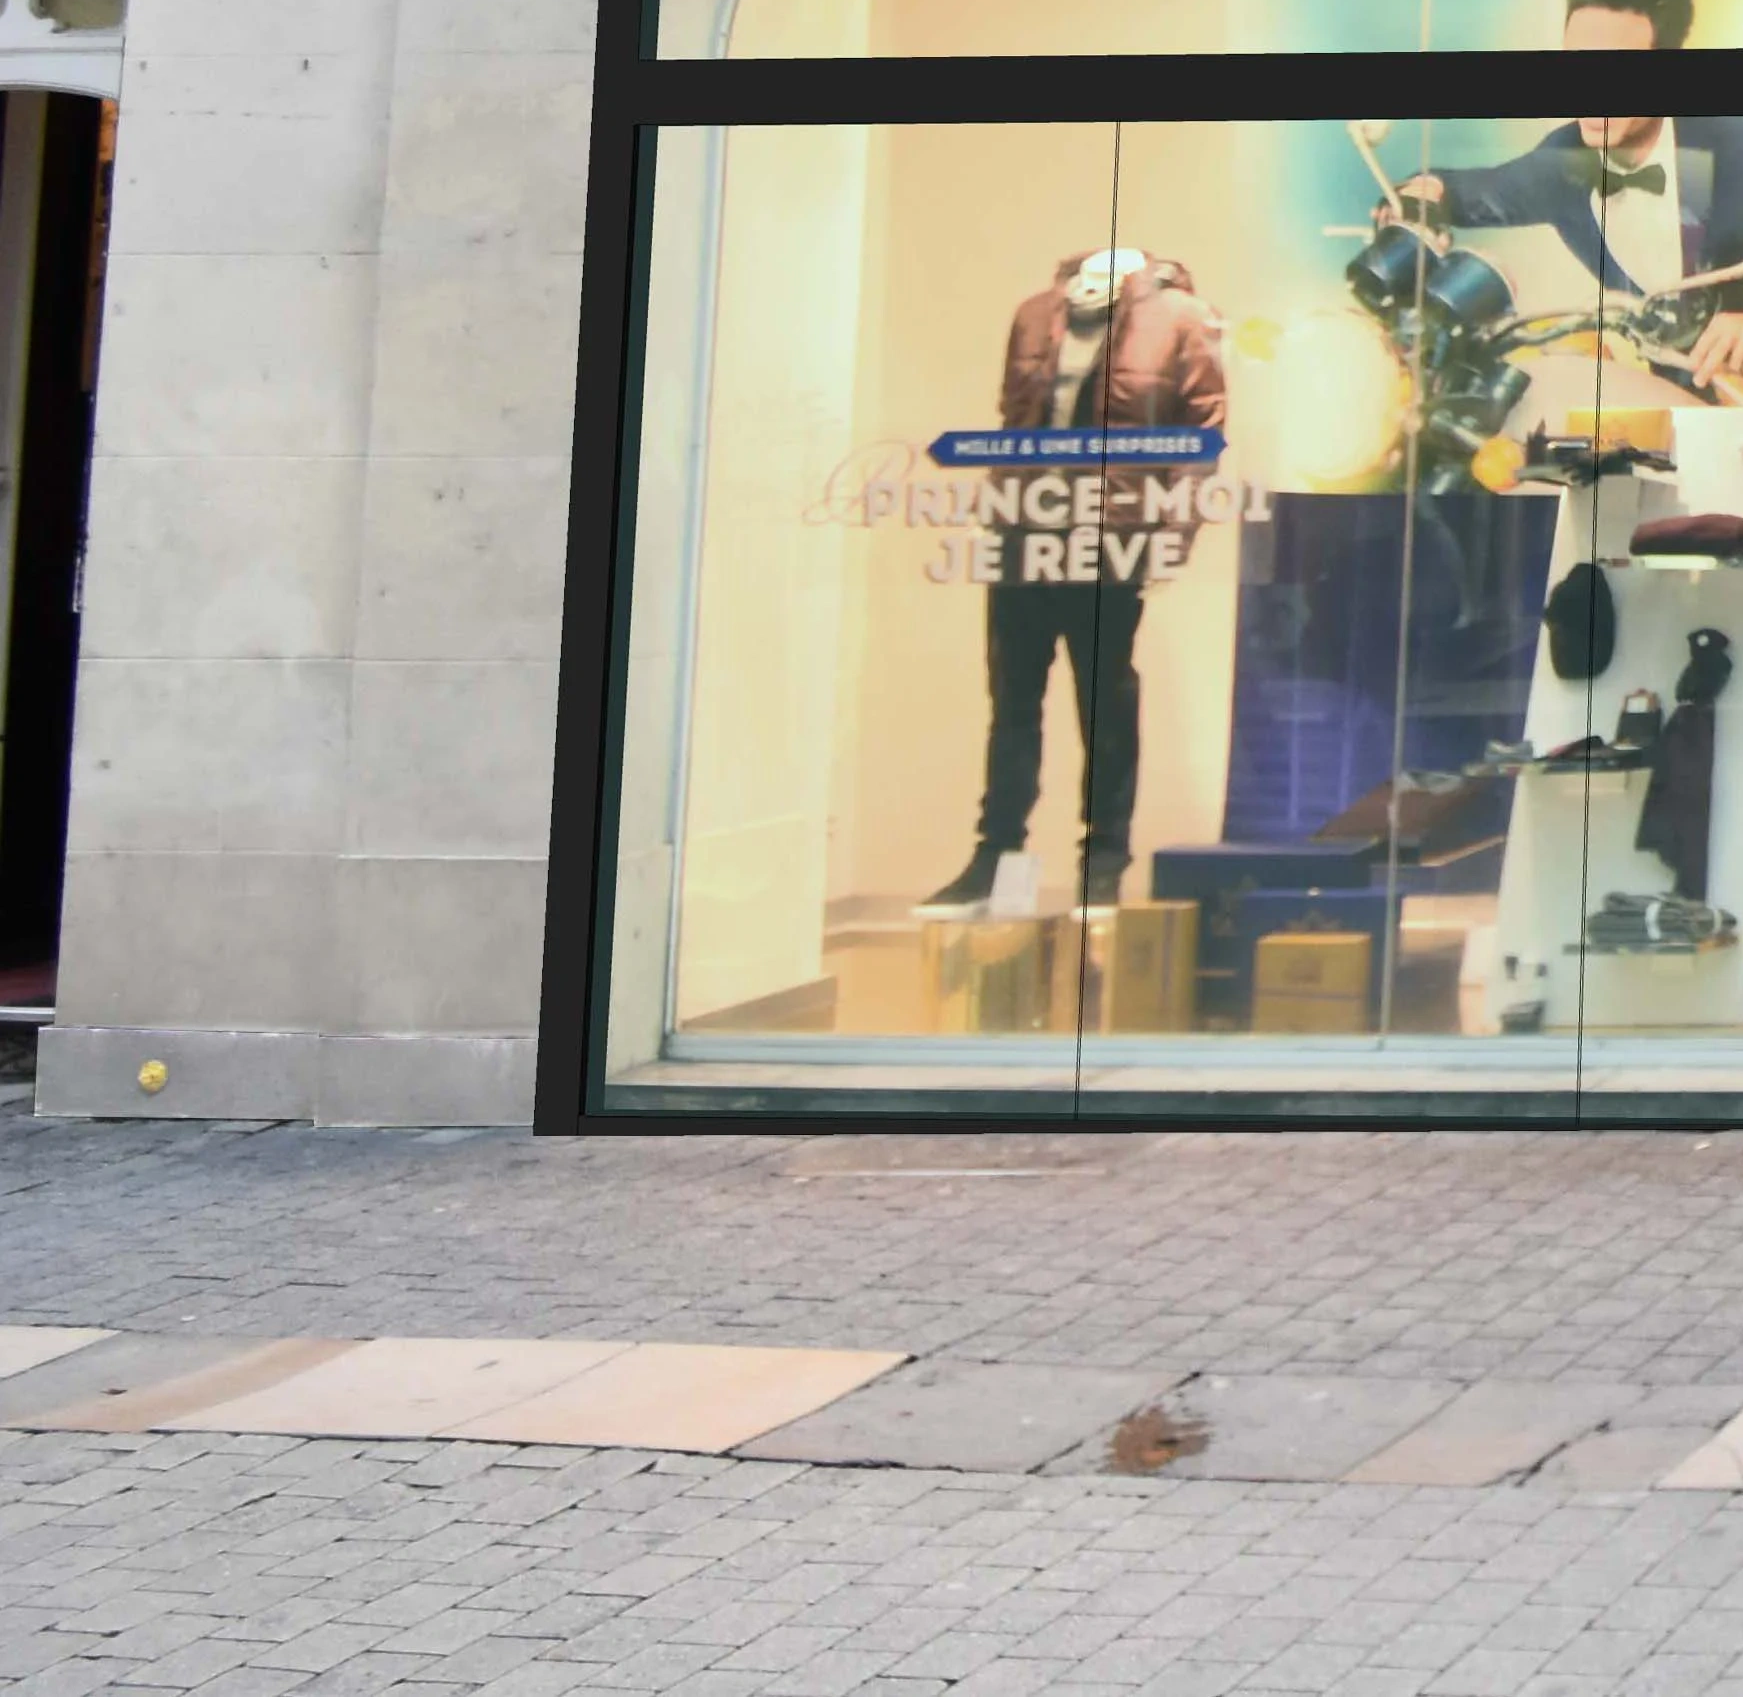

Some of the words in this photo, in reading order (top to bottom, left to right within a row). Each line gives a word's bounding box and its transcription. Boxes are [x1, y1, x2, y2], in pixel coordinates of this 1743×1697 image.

[954, 438, 1013, 455] MILLE
[1039, 437, 1082, 454] UNE
[923, 531, 1004, 583] JE
[1023, 526, 1187, 583] RÊVE
